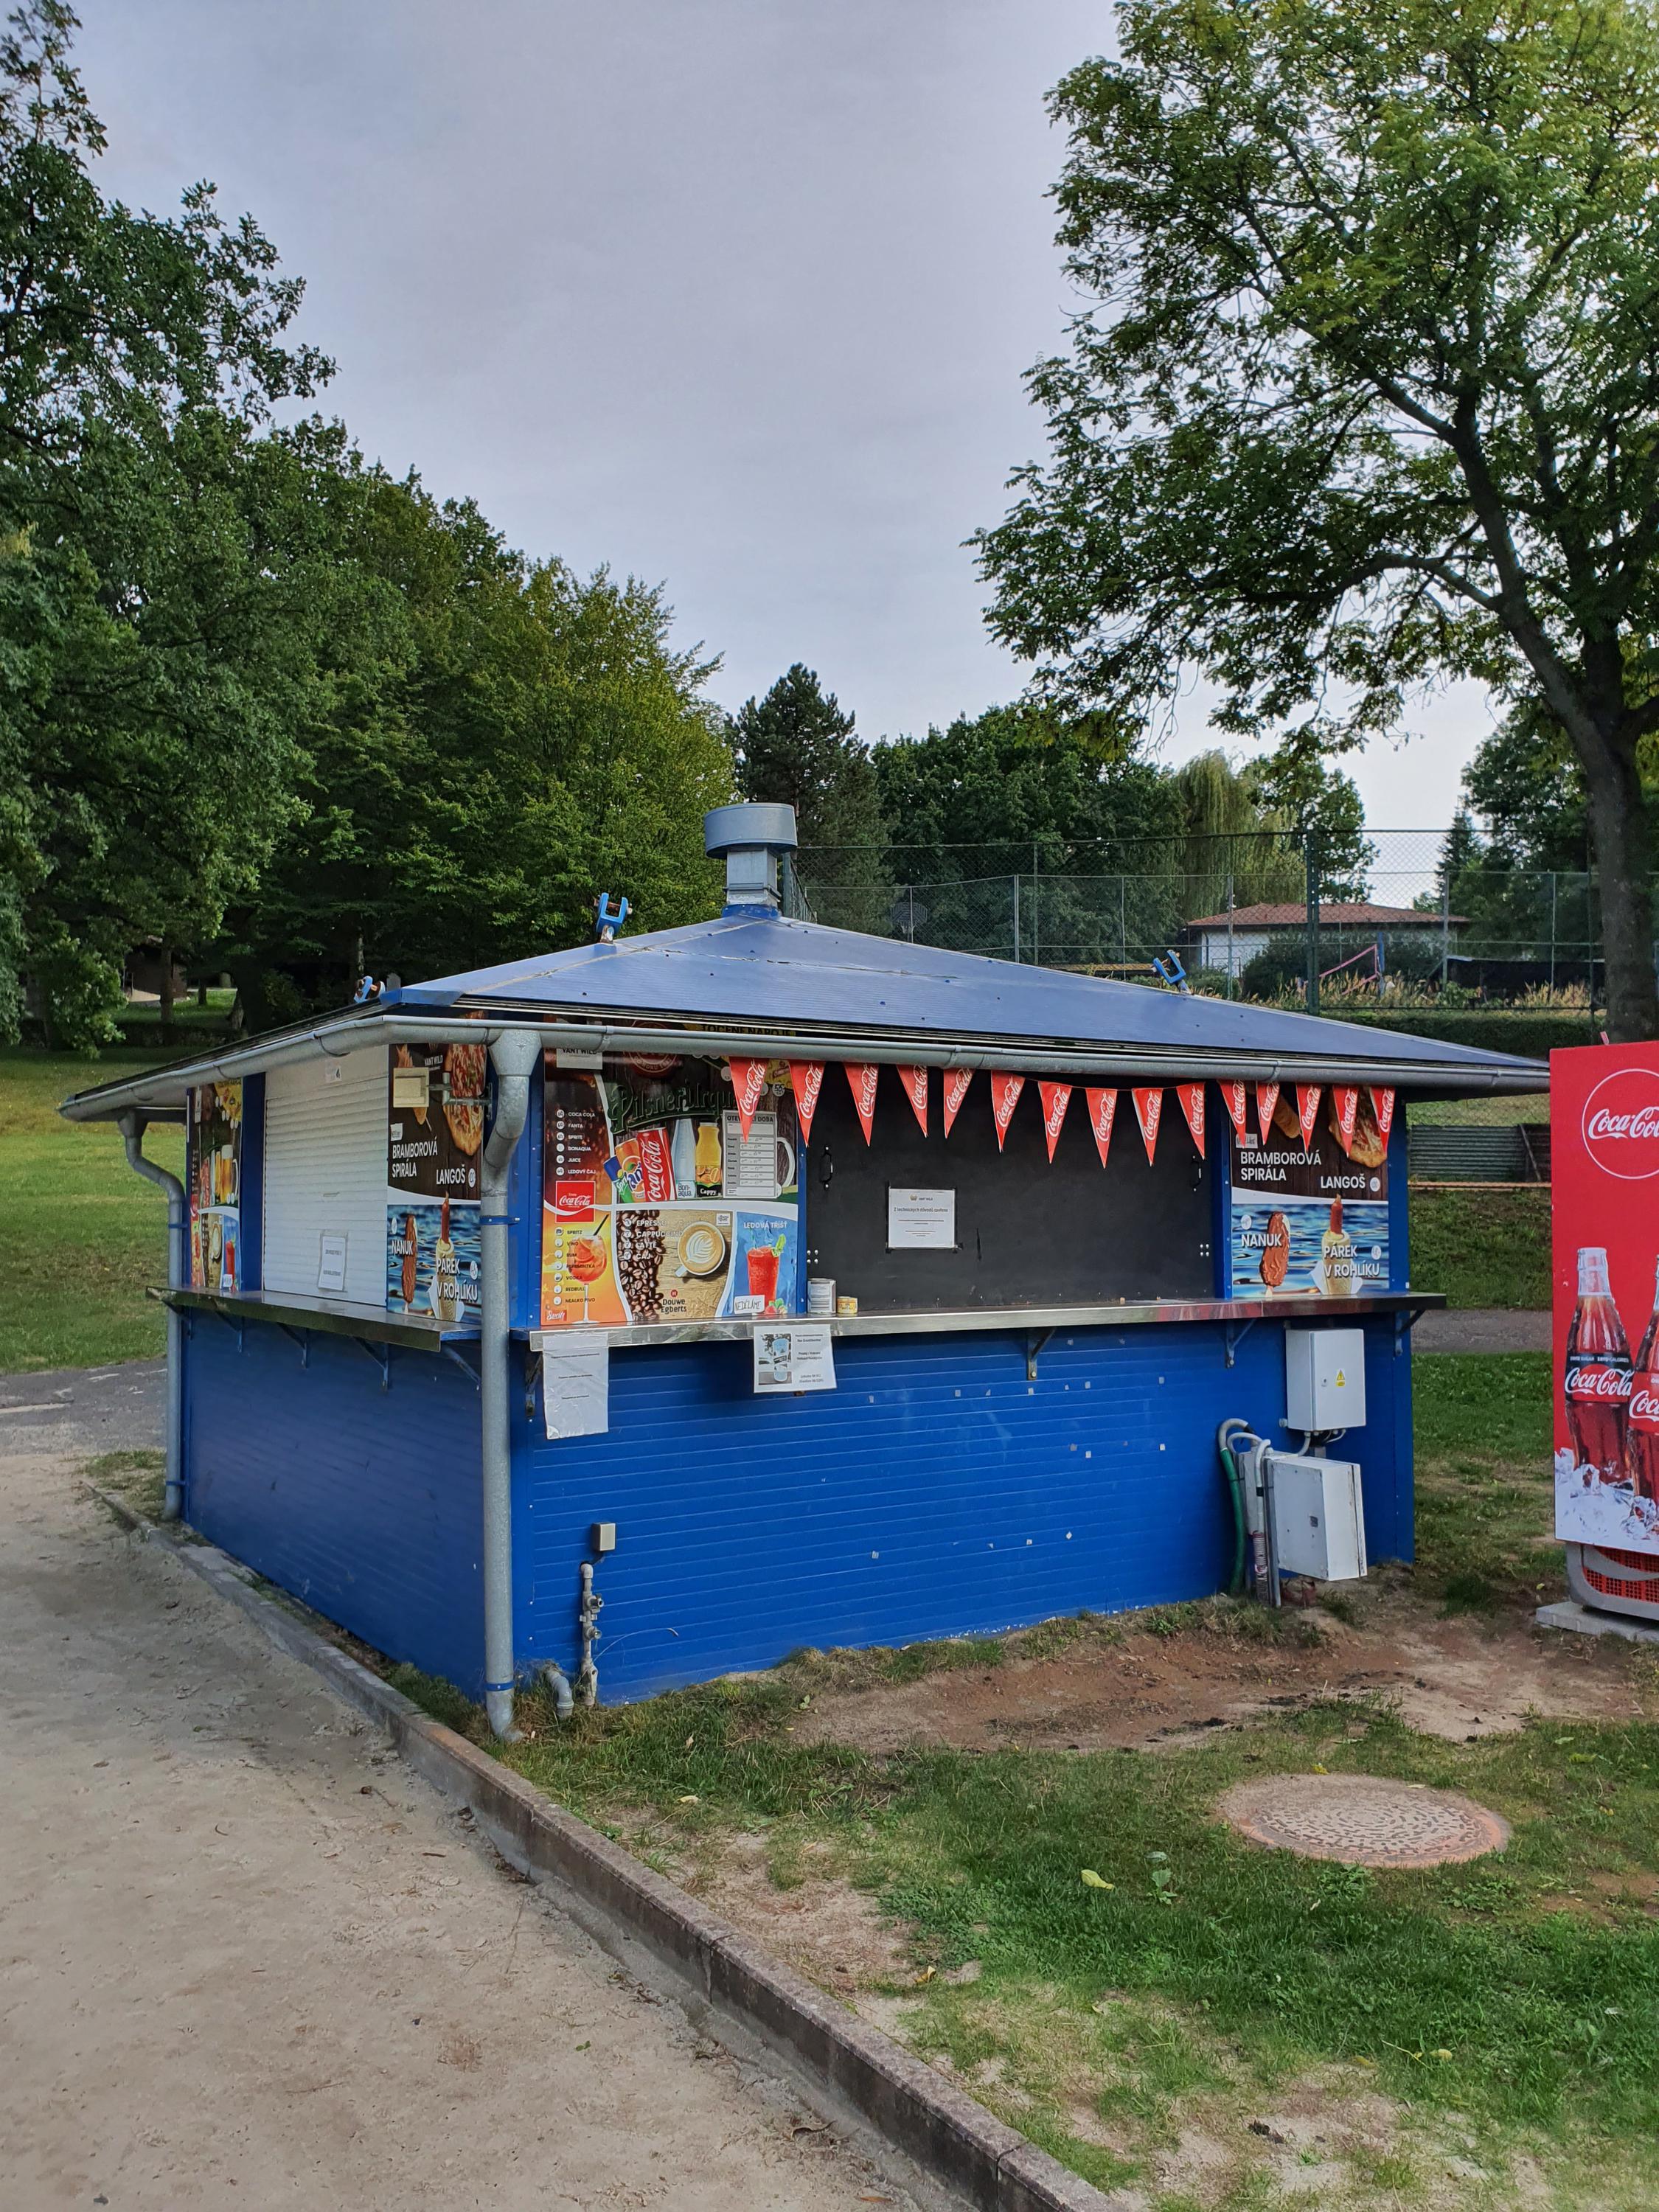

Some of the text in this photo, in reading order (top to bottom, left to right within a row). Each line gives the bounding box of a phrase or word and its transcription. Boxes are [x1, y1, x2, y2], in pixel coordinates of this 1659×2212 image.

[607, 1084, 683, 1135] Pilsner
[392, 1135, 438, 1160] BRAMBOROVÁ
[1240, 1149, 1322, 1166] BRAMBOROVÁ
[392, 1158, 417, 1178] SPIRÁLA
[436, 1164, 466, 1185] LANGOŠ
[641, 1138, 664, 1202] Coca-Cola
[1240, 1165, 1287, 1182] SPIRÁLA
[1321, 1175, 1366, 1189] LANGOŠ
[559, 1194, 592, 1206] Coca-Cola
[700, 1188, 717, 1196] Cappy
[636, 1230, 685, 1238] CAPPUCCINO
[1241, 1233, 1283, 1248] NANUK
[392, 1239, 414, 1256] NANUK
[1324, 1242, 1358, 1259] PÁREK
[436, 1253, 461, 1273] PÁREK
[1325, 1259, 1380, 1278] V ROHLÍKU
[437, 1279, 479, 1301] V ROHLÍKU
[661, 1305, 687, 1315] Egberts
[1564, 1367, 1635, 1397] Coca-Cola
